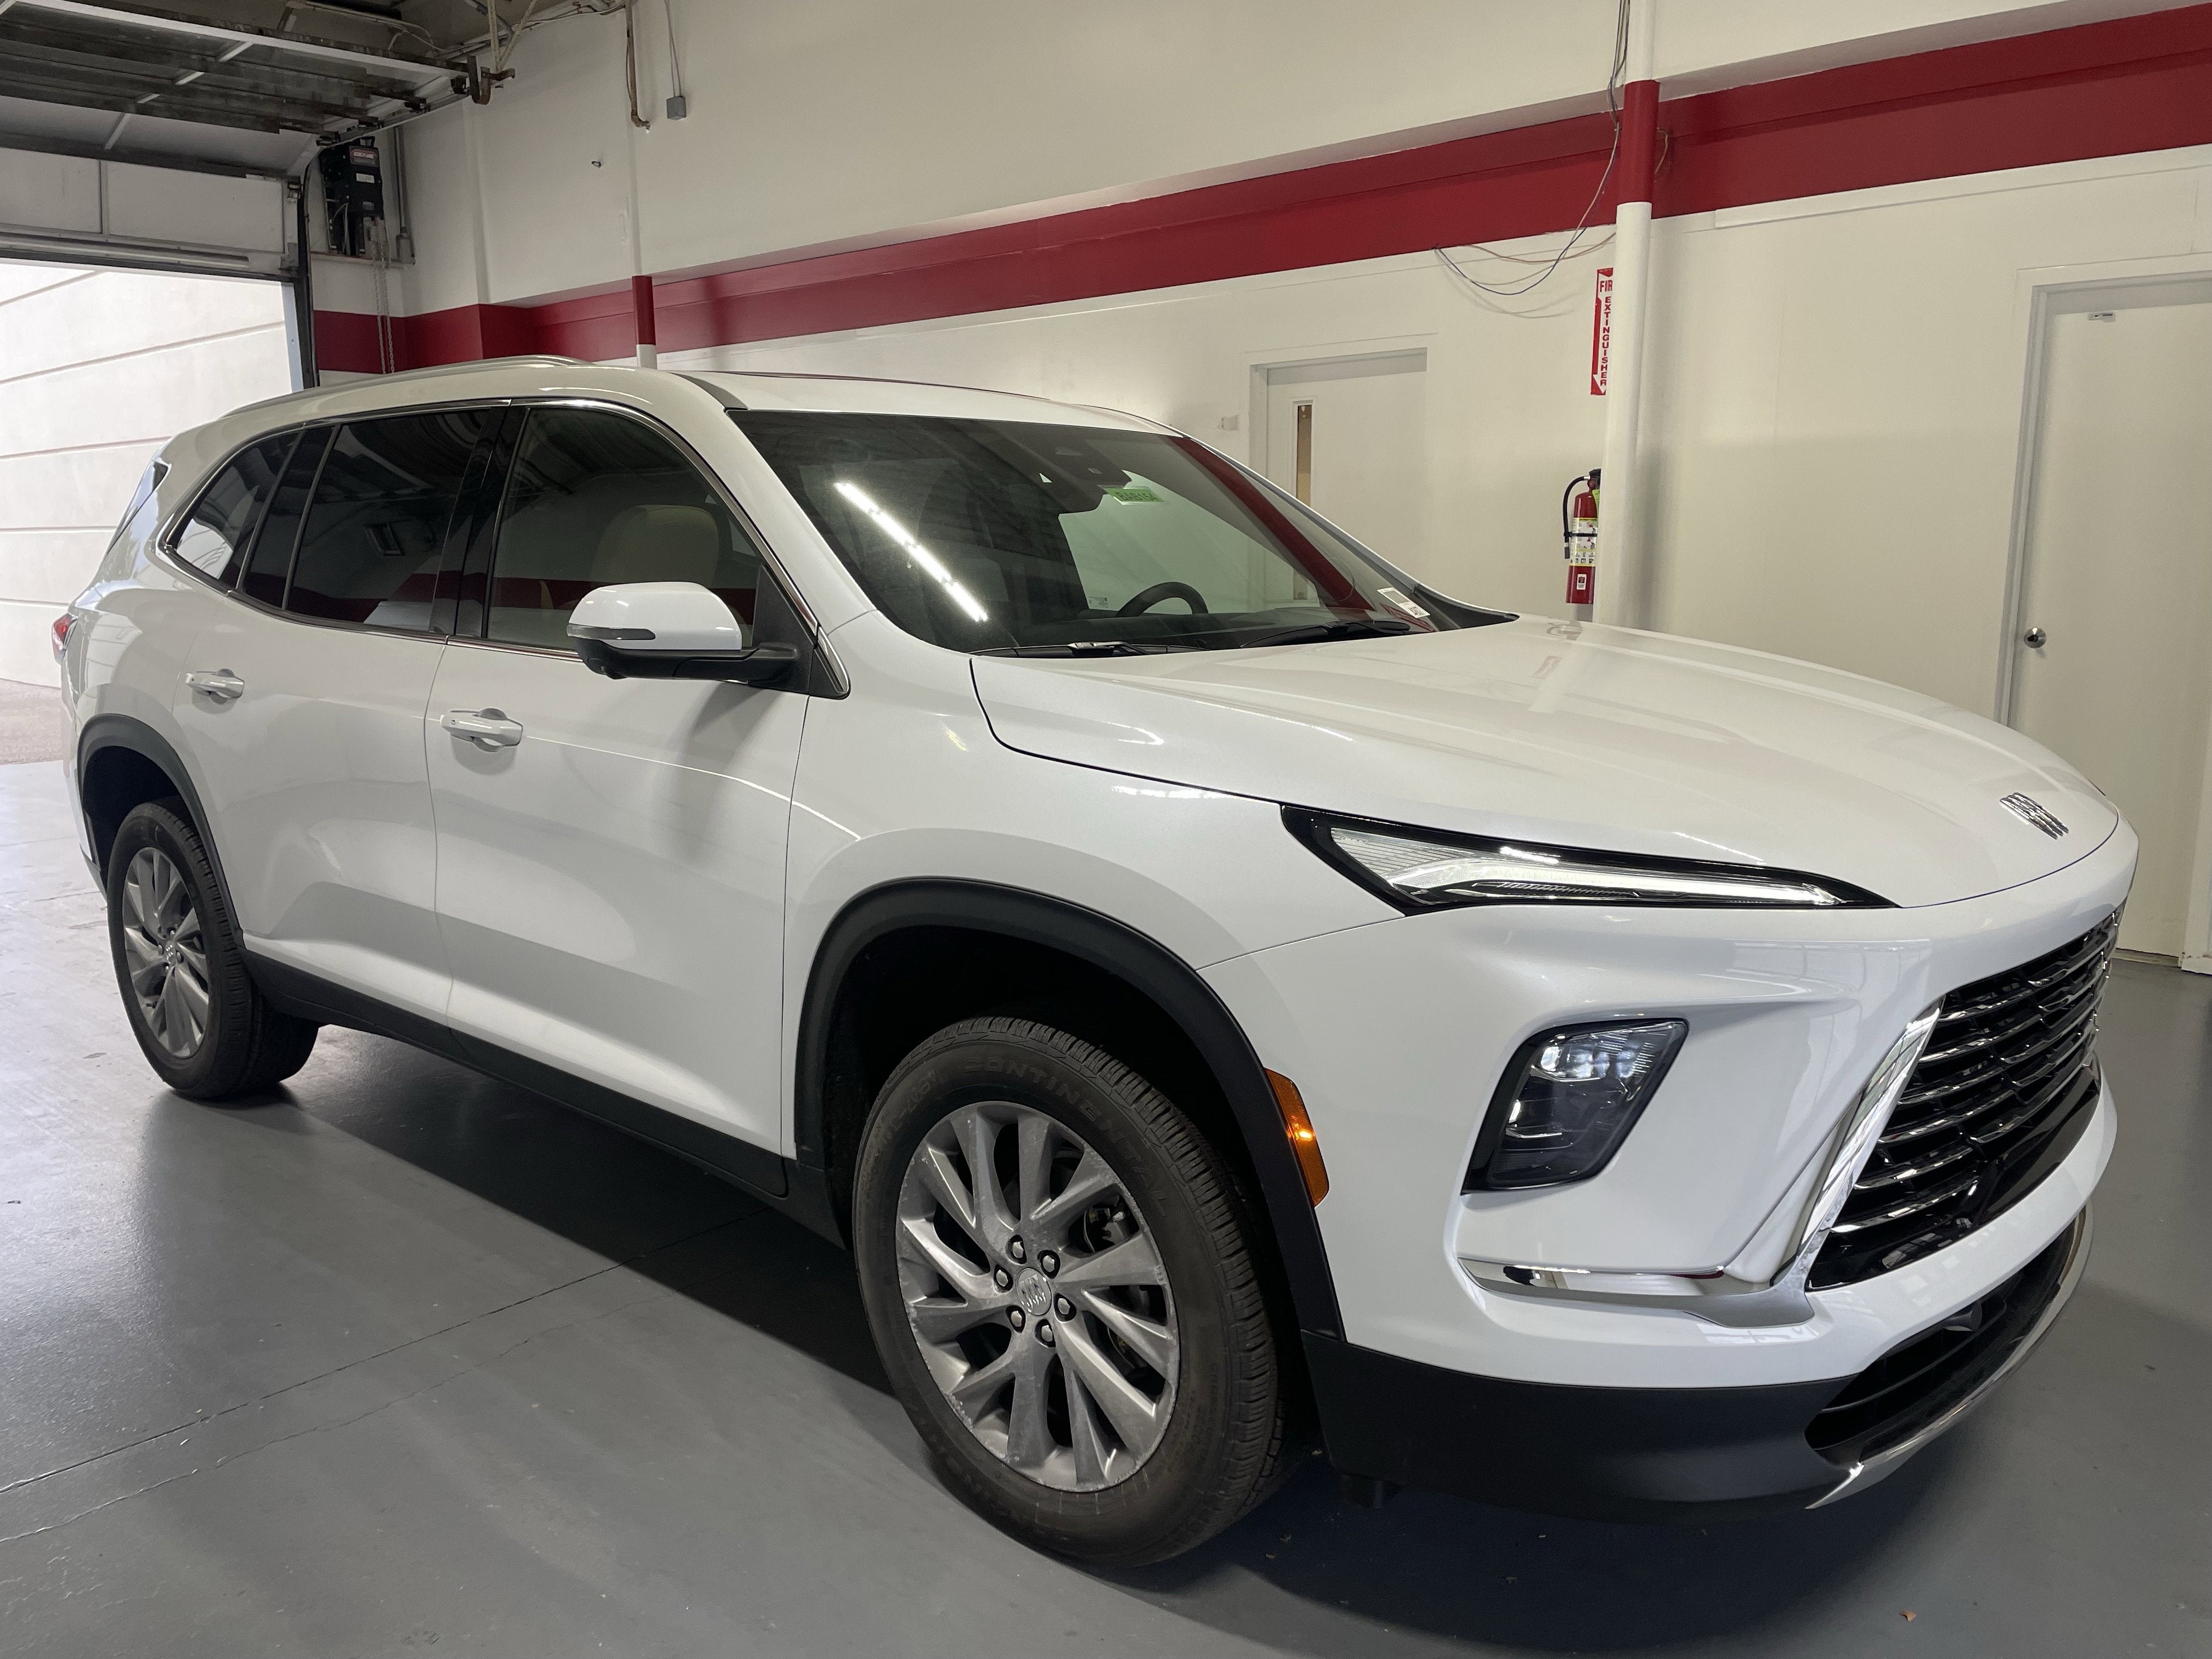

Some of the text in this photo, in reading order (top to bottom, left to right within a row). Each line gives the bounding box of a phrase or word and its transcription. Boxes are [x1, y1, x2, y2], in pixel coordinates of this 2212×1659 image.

[1600, 280, 1613, 292] FIR
[1600, 296, 1612, 386] EXTINGUISHER
[964, 1056, 1166, 1217] CONTINENTAL
